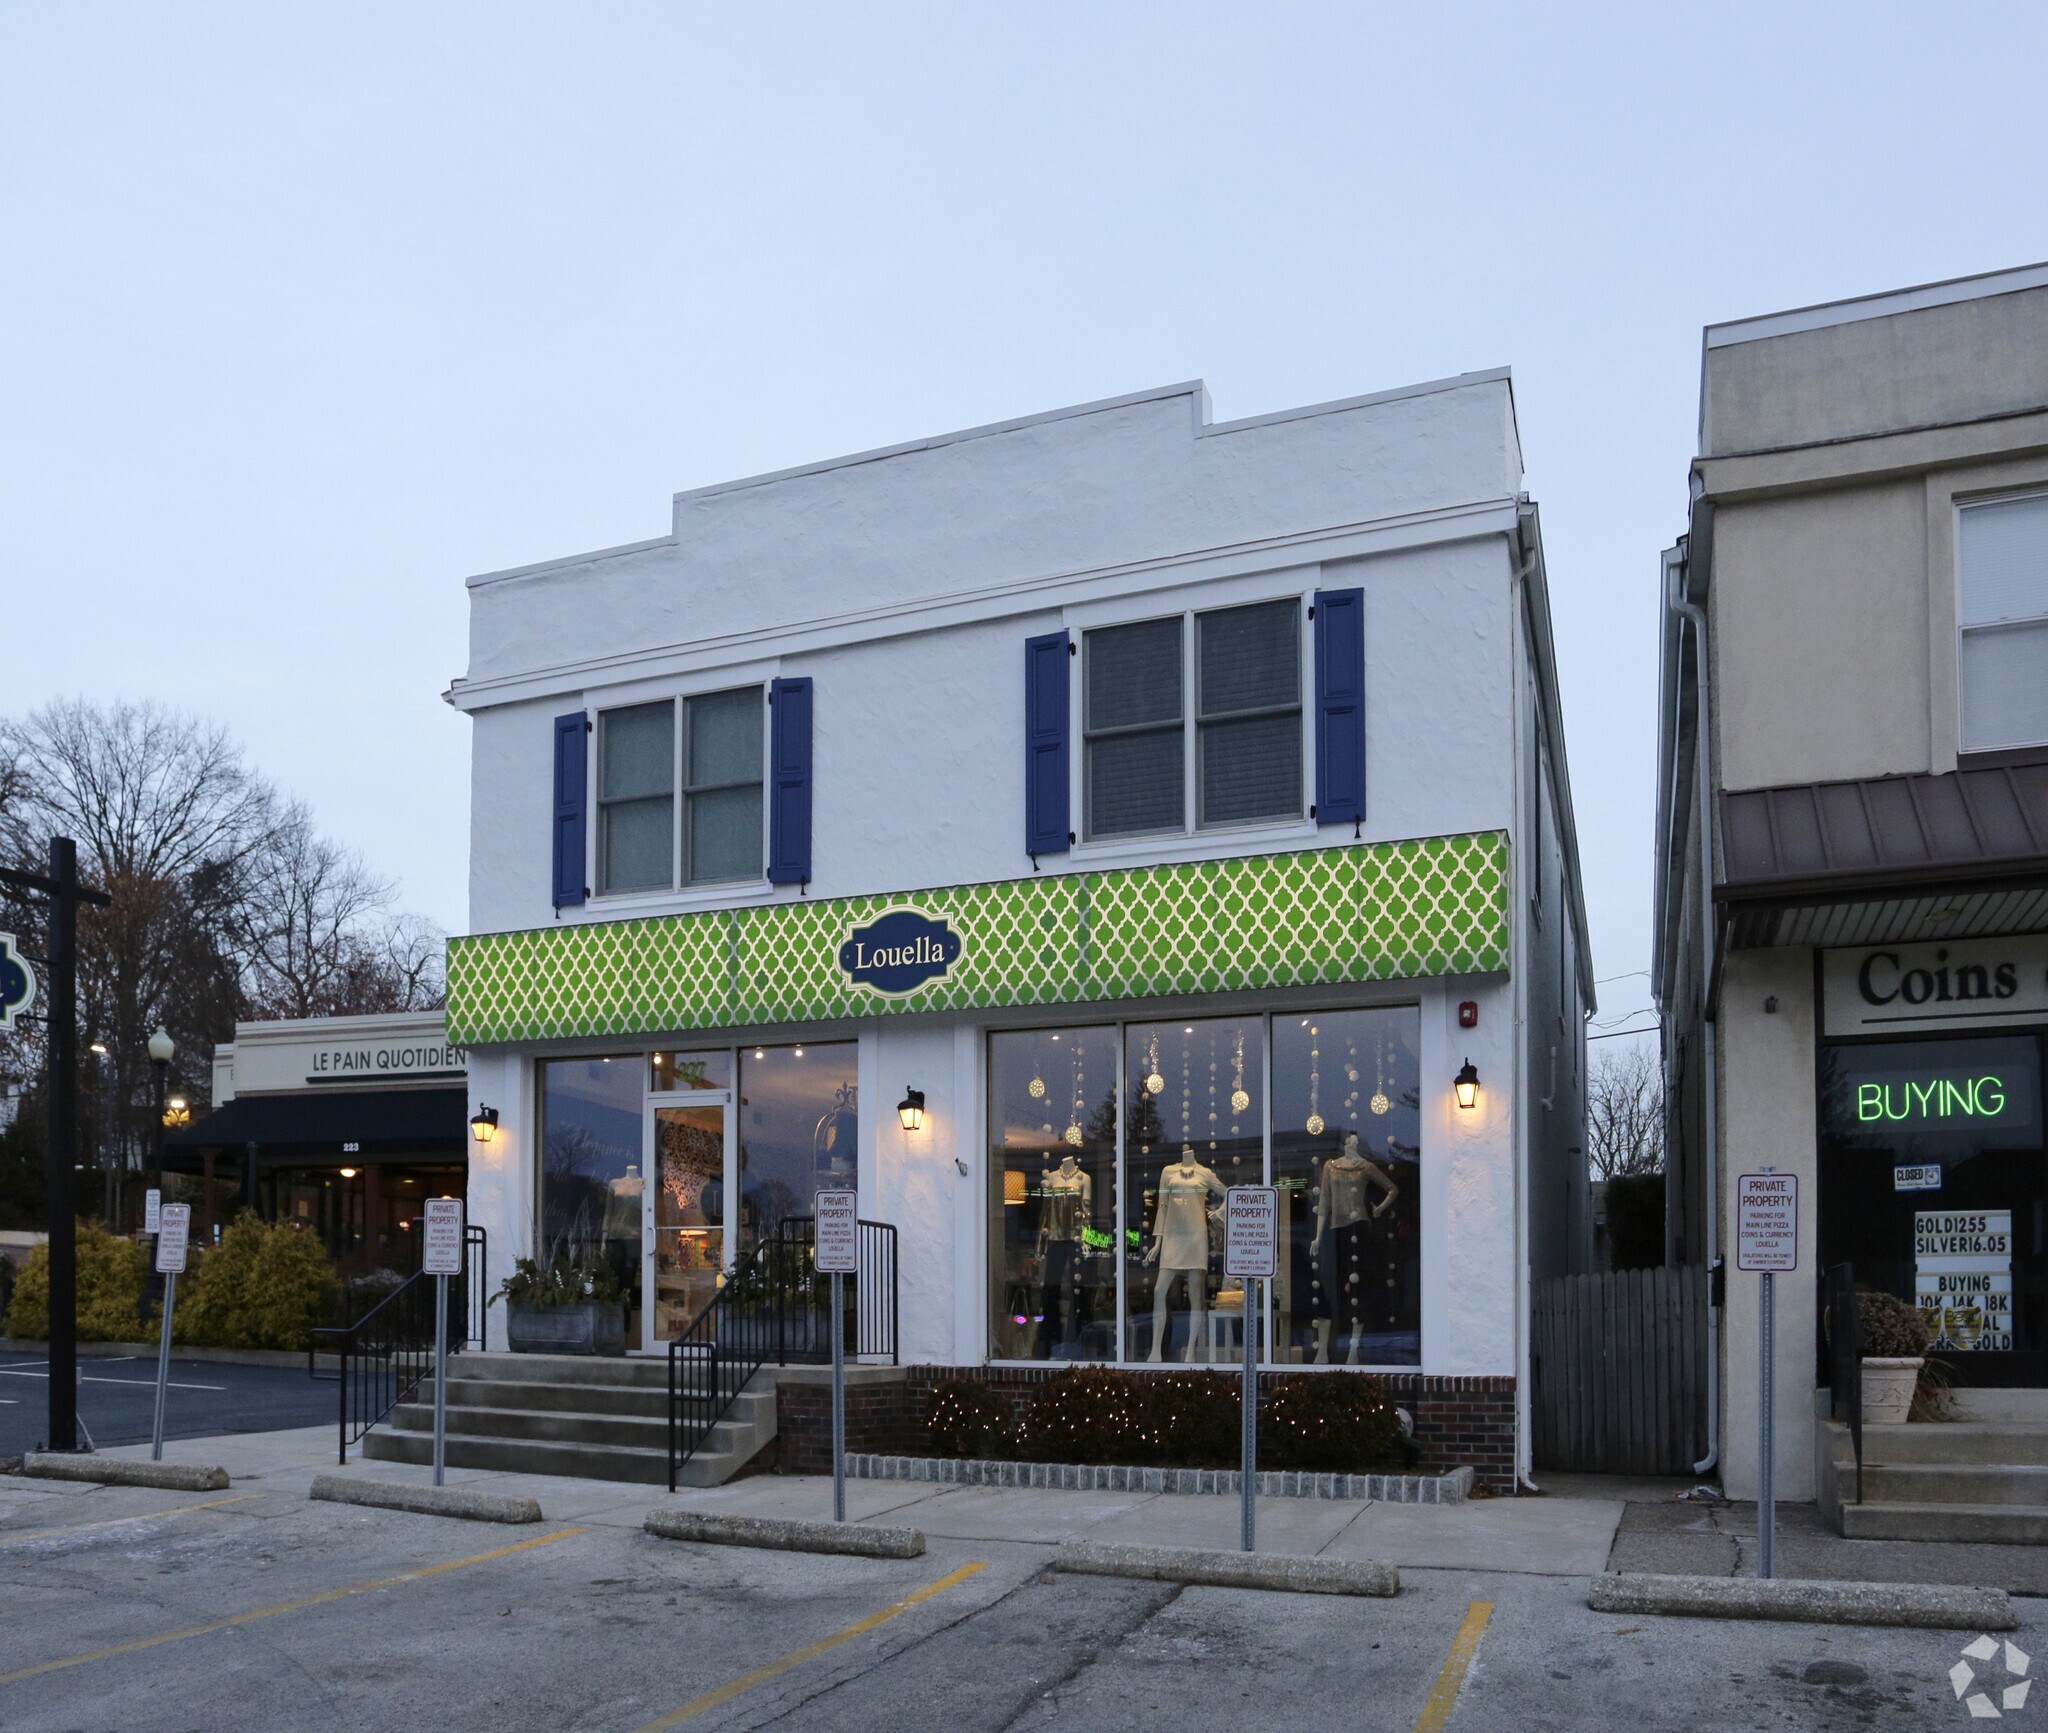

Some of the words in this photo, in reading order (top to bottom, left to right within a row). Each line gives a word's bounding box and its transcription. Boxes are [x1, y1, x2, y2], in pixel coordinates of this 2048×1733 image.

[855, 936, 945, 970] Louella
[1858, 948, 2017, 1006] Coins
[313, 1053, 328, 1071] LE
[334, 1051, 370, 1070] PAIN
[376, 1047, 466, 1070] QUOTIDIEN
[1858, 1076, 2005, 1121] BUYING
[343, 1142, 359, 1152] 223
[1896, 1168, 1924, 1181] CLOSED
[1750, 1181, 1786, 1192] PRIVATE
[824, 1197, 848, 1206] PRIVATE
[1236, 1194, 1267, 1204] PRIVATE
[1742, 1196, 1792, 1207] PROPERTY
[432, 1205, 455, 1213] PRIVATE
[820, 1209, 853, 1218] PROPERTY
[1230, 1208, 1272, 1218] PROPERTY
[428, 1216, 458, 1224] PROPERTY
[1939, 1276, 1990, 1292] BUYING
[1952, 1296, 1975, 1307] 14K
[1984, 1296, 2008, 1312] 18K
